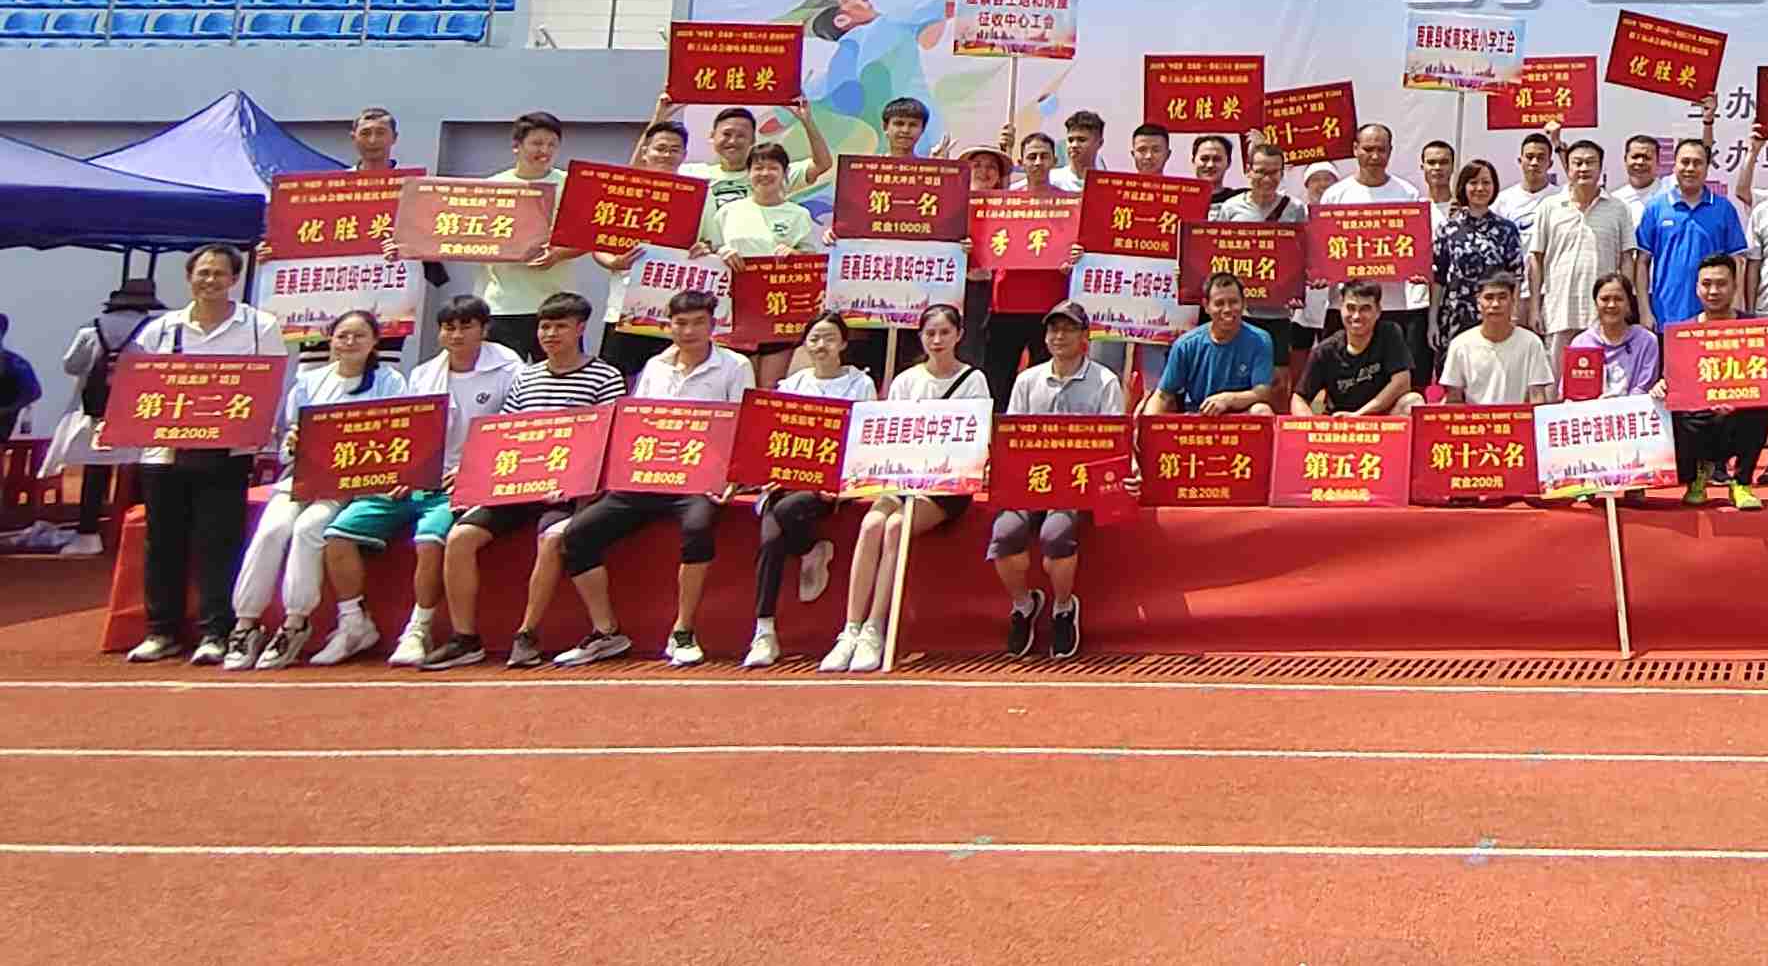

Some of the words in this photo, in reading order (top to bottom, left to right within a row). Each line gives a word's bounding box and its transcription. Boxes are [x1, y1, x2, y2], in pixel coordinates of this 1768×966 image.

[978, 11, 1054, 30] 征收中心工会
[694, 67, 776, 91] 优胜奖
[1629, 55, 1696, 88] 优胜奖
[1168, 97, 1242, 121] 优胜奖
[1515, 88, 1573, 109] 第二名
[869, 190, 937, 216] 第一名
[297, 214, 393, 243] 优胜奖
[434, 212, 515, 238] 第五名
[592, 200, 669, 234] 第五名
[1110, 206, 1180, 234] 第一名
[990, 228, 1051, 257] 季军
[1327, 236, 1414, 259] 第十五名
[274, 263, 408, 295] 鹿寨县第四初级中学工会
[1210, 255, 1276, 281] 第四名
[1083, 268, 1176, 298] 鹿寨县第一初级中学
[1697, 355, 1768, 382] 第九名
[133, 393, 253, 420] 第十二名
[154, 428, 220, 440] 奖金200元
[331, 438, 411, 469] 第六名
[492, 446, 571, 477] 第一名
[629, 435, 705, 466] 第三名
[766, 431, 840, 465] 第四名
[1431, 442, 1525, 470] 第十六名
[769, 467, 824, 484] 奖金700元
[1027, 463, 1089, 493] 冠军
[1159, 453, 1251, 479] 第十二名
[1304, 453, 1381, 480] 第五名
